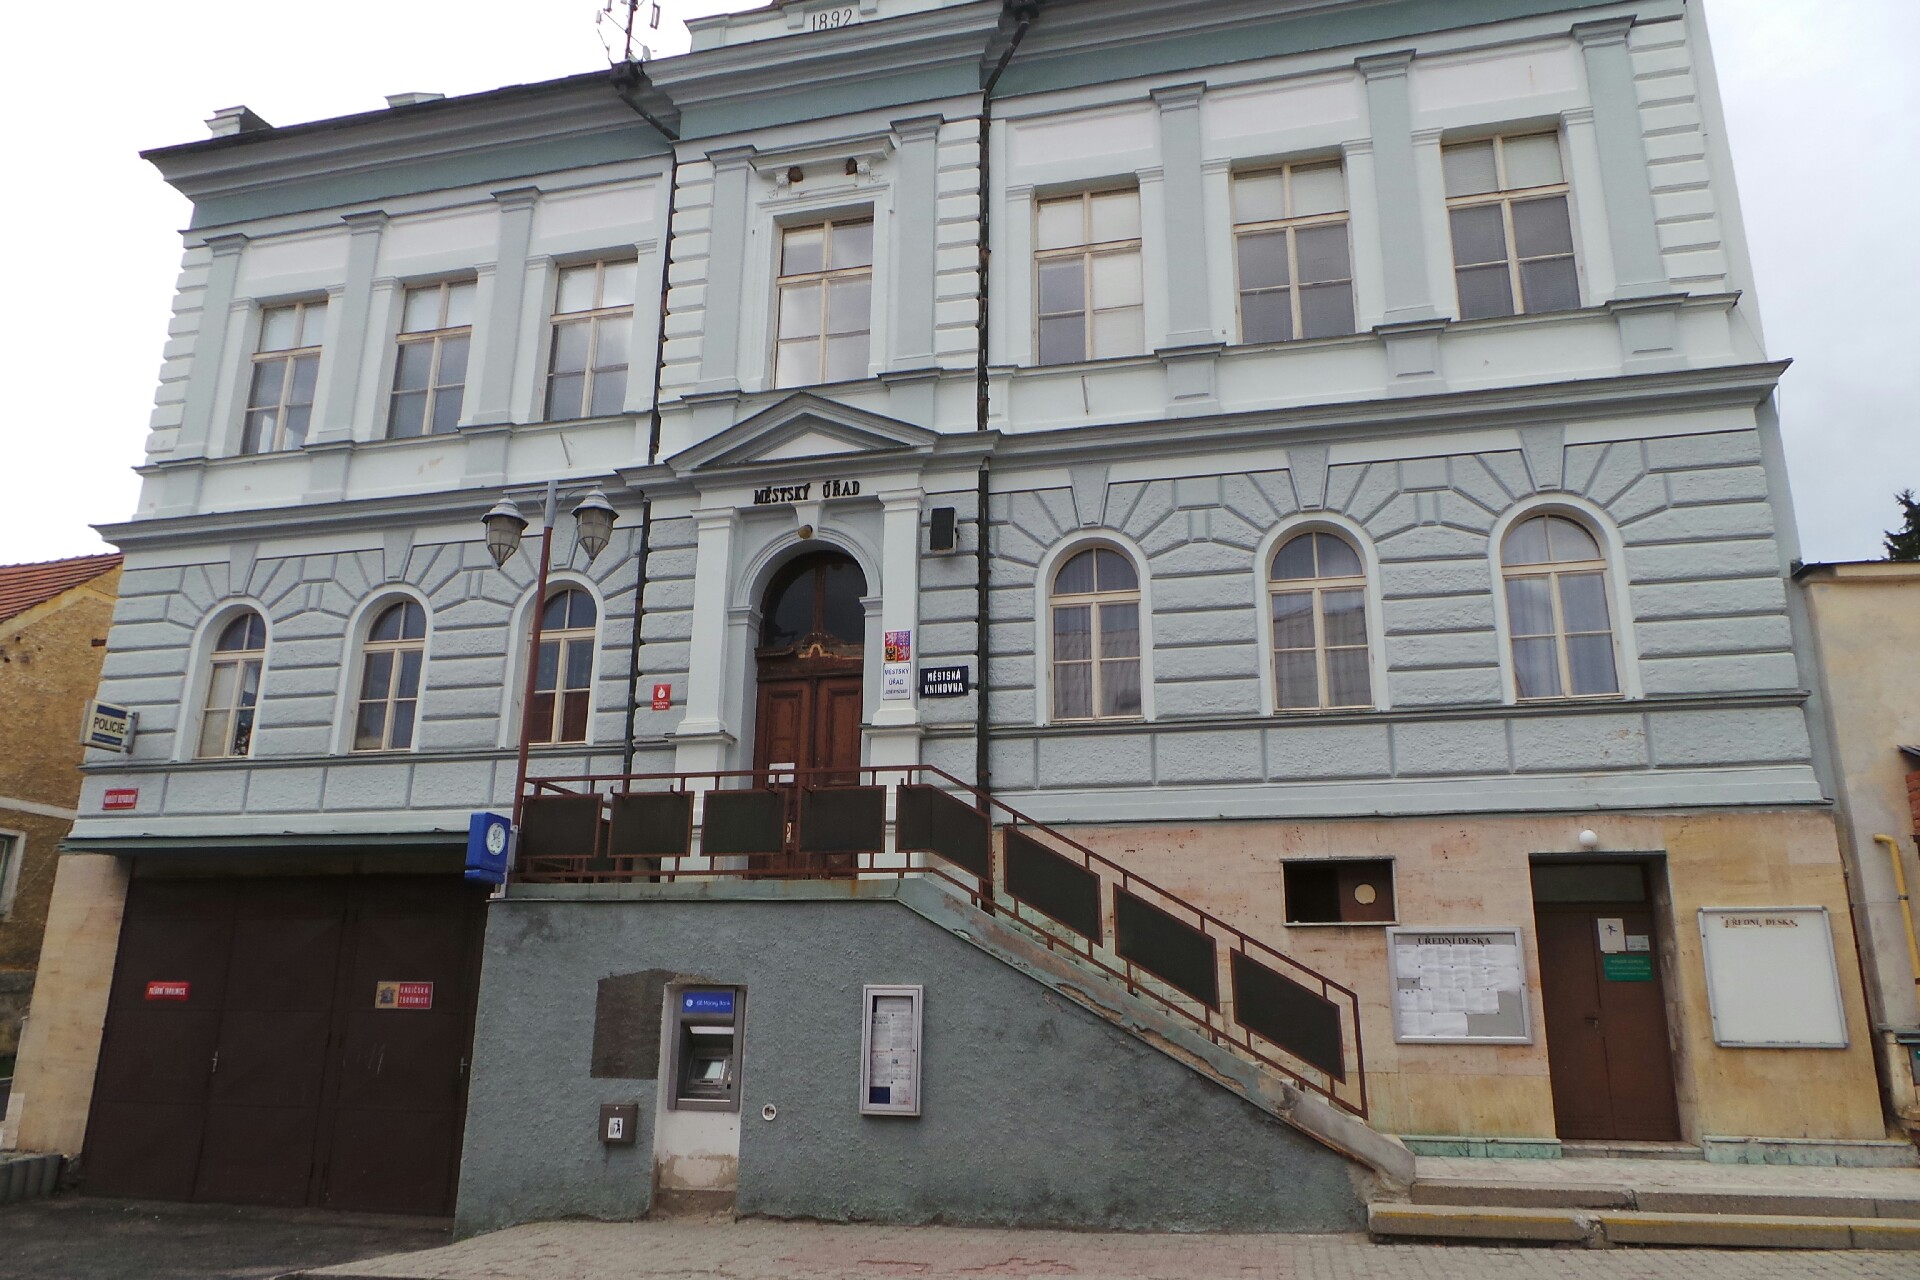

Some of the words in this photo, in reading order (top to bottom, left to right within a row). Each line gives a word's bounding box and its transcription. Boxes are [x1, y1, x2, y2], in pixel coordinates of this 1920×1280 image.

[812, 8, 853, 32] 1892
[753, 482, 811, 504] MĚSTSKÝ
[822, 479, 860, 499] ÚŘAD
[927, 669, 961, 682] MĚSTSKÁ
[924, 682, 964, 695] KNIHOVNA
[93, 716, 126, 734] POLICIE
[1417, 935, 1456, 945] ÚŘEDNÍ
[1458, 937, 1492, 945] DESKA
